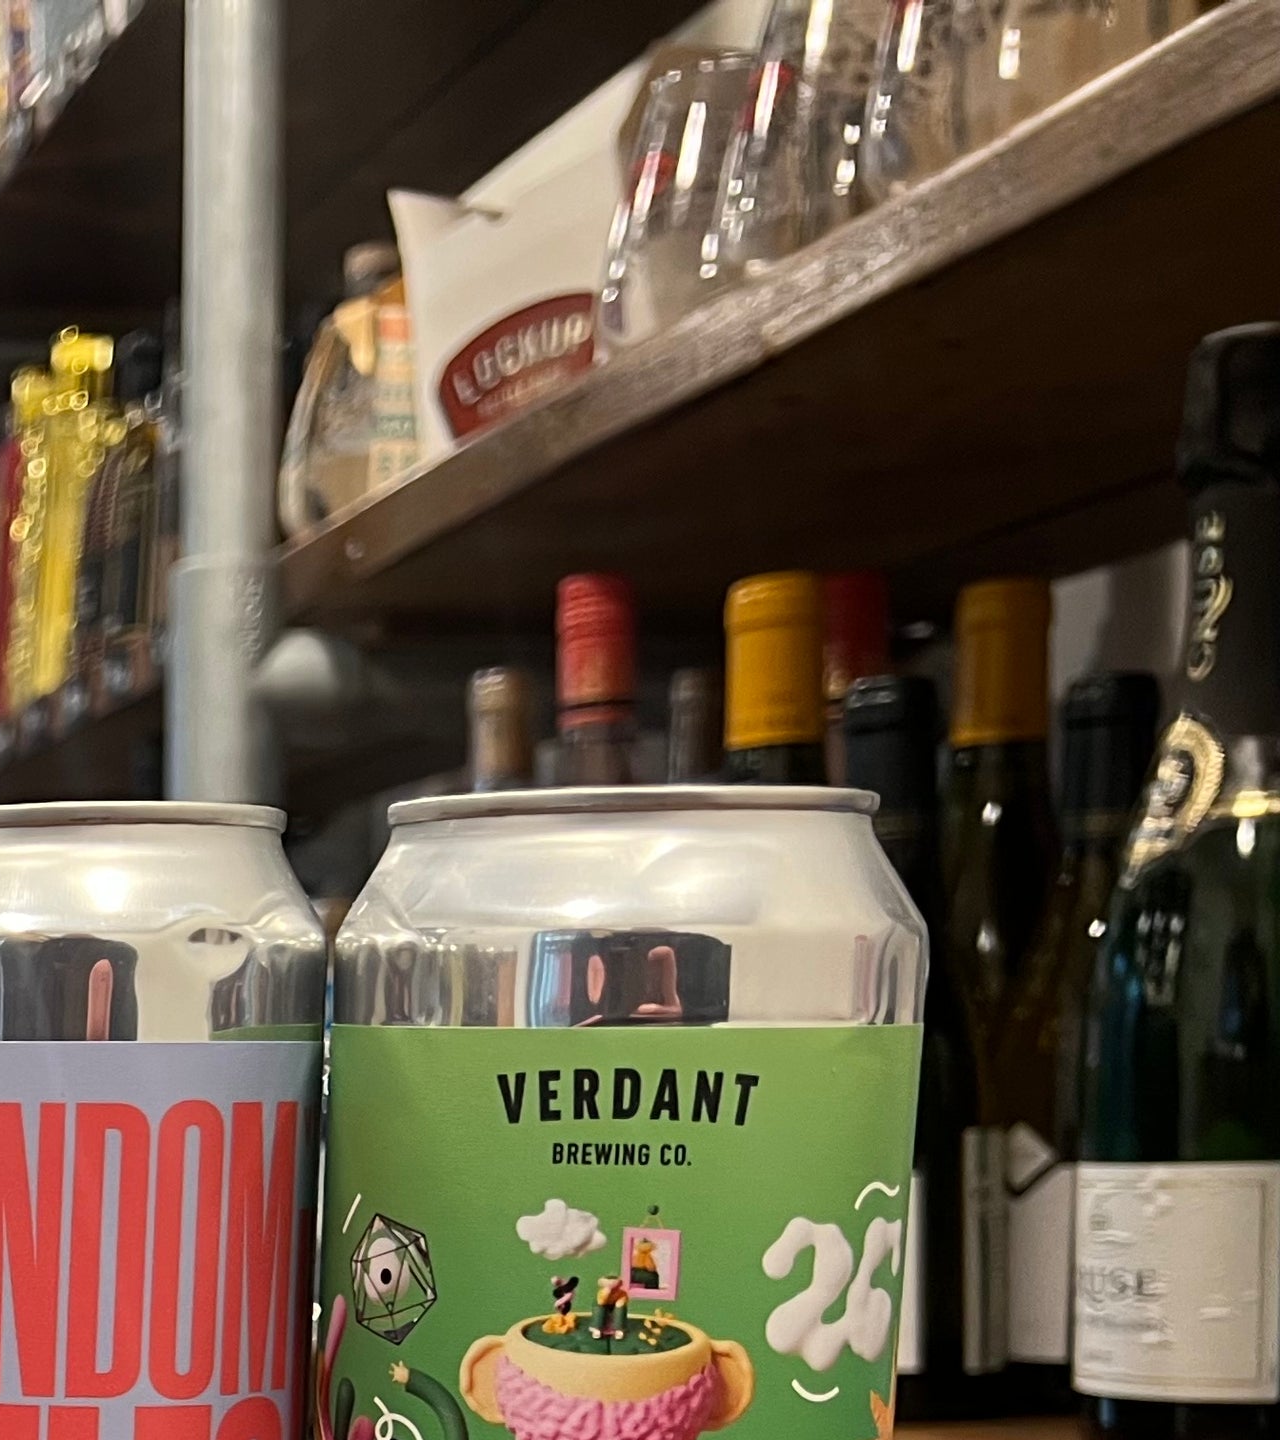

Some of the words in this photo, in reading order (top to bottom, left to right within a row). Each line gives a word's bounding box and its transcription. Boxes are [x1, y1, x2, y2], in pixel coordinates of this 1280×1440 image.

[496, 1068, 761, 1126] VERDANT
[551, 1143, 650, 1167] BREWING
[659, 1143, 692, 1166] CO.
